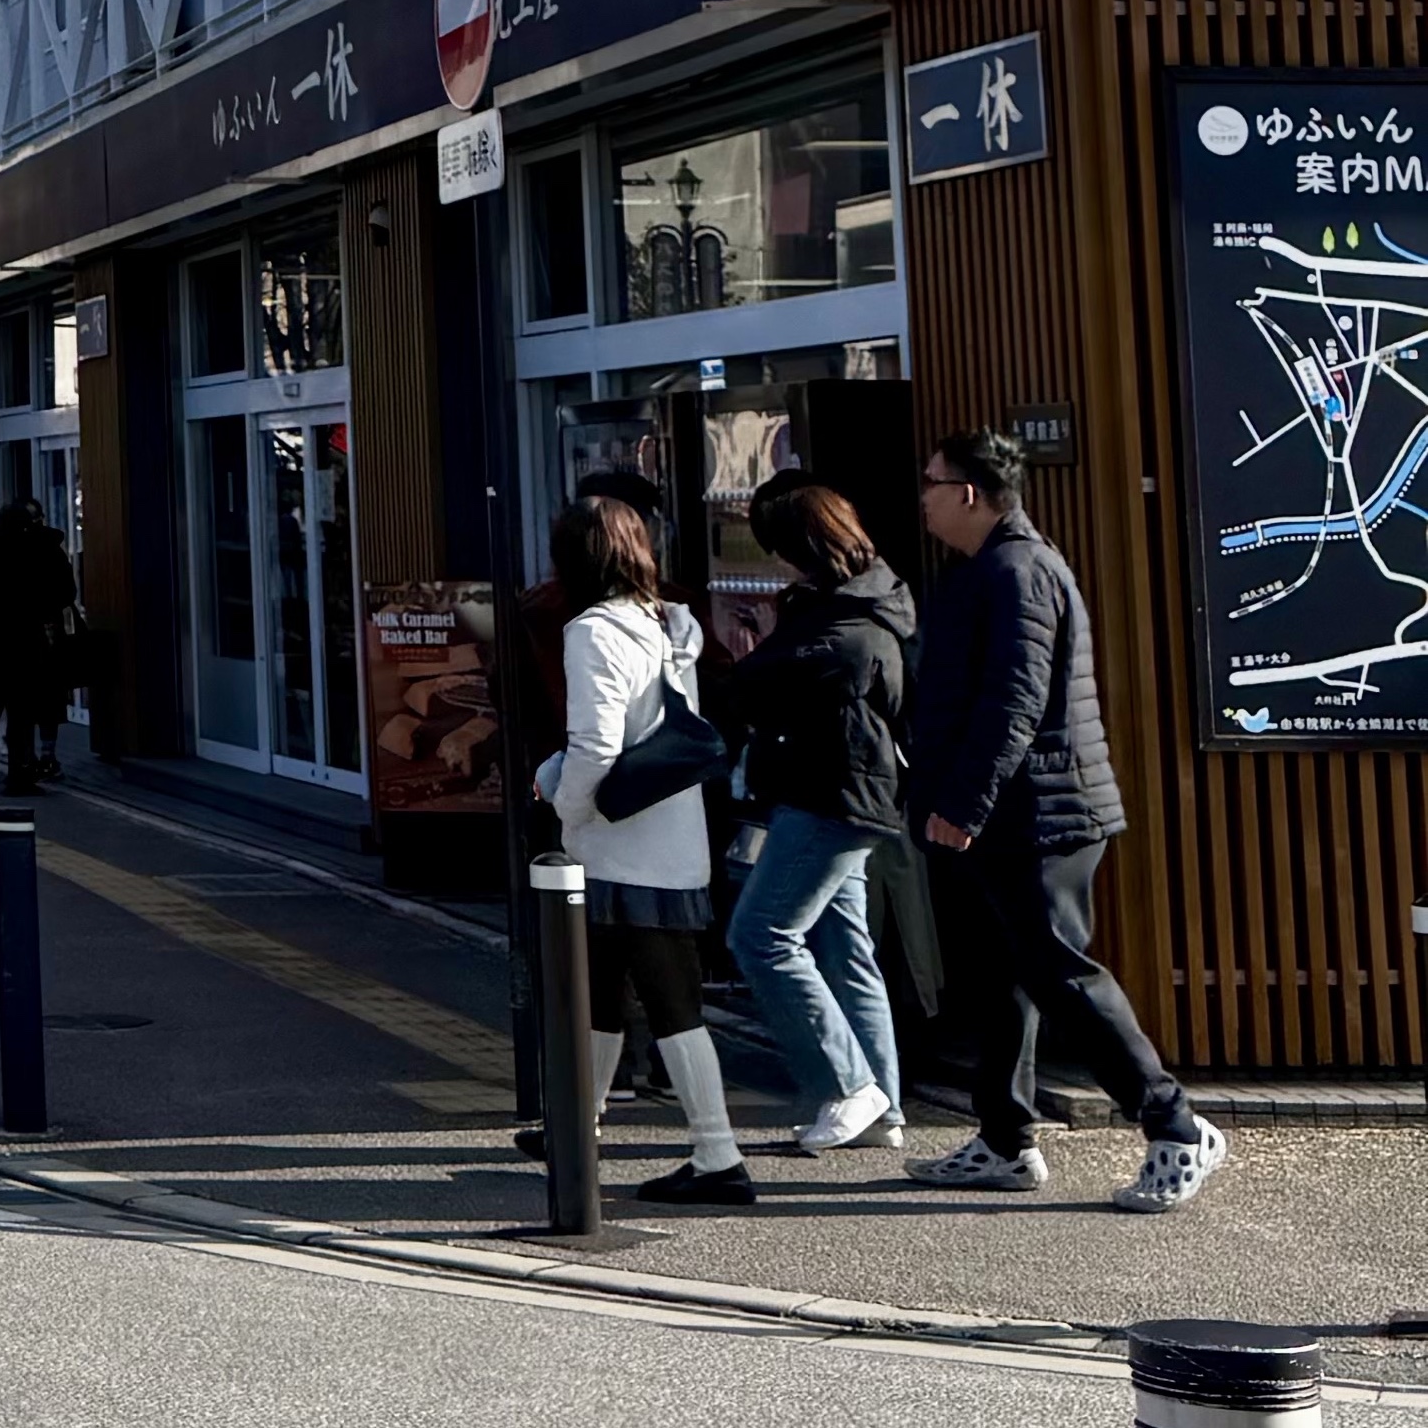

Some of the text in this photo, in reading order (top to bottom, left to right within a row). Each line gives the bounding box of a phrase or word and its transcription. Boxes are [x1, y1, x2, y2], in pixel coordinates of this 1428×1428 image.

[292, 22, 358, 121] 一休
[920, 56, 1023, 152] 一休
[1256, 107, 1413, 145] ゆふいん
[1296, 152, 1428, 194] 案内M
[372, 612, 456, 627] Milk Caramel
[380, 630, 449, 644] Baked Bar
